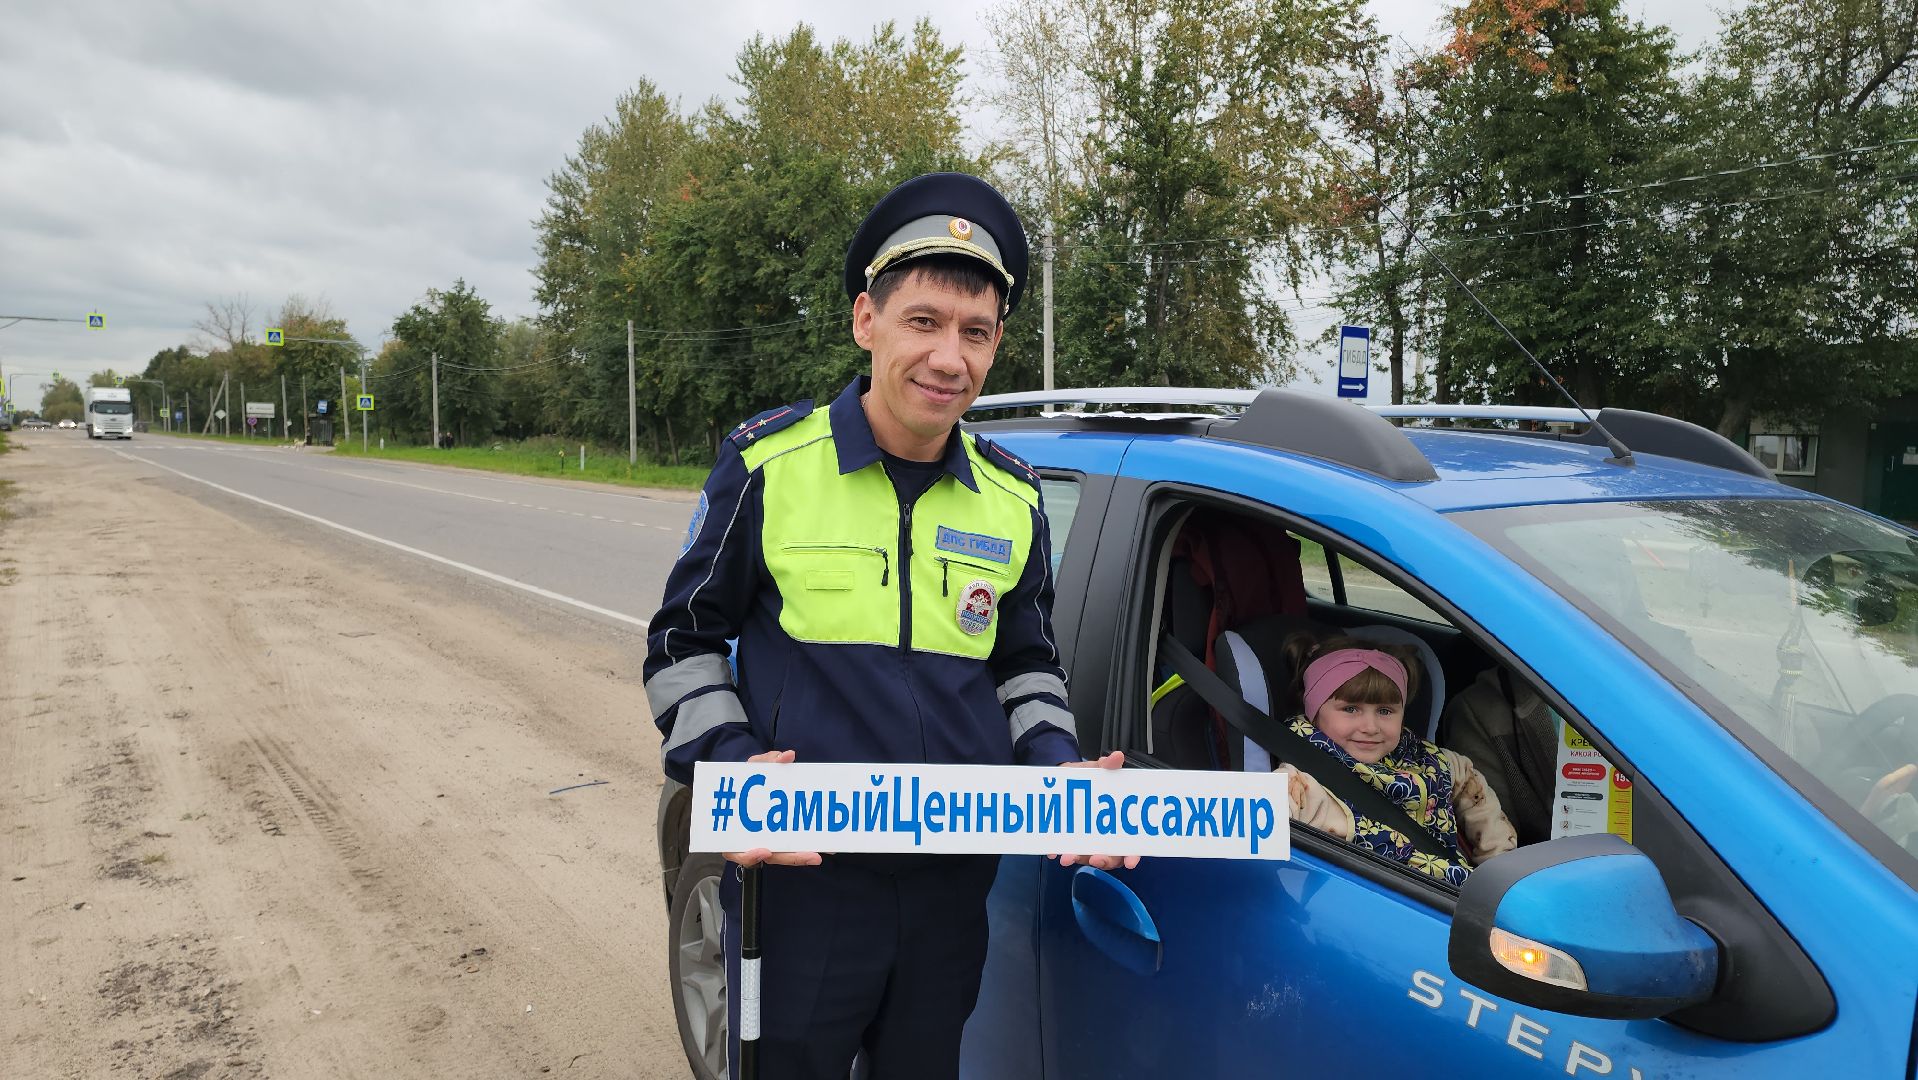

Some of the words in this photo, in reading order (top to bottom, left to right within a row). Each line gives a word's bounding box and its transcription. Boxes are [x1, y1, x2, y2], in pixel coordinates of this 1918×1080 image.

[1342, 349, 1366, 366] ГИБДД
[943, 532, 965, 547] ДПС
[969, 537, 1006, 556] ГИБДД
[712, 773, 1275, 854] #СамыйЦенныйПассажир
[1408, 970, 1642, 1080] STEP
